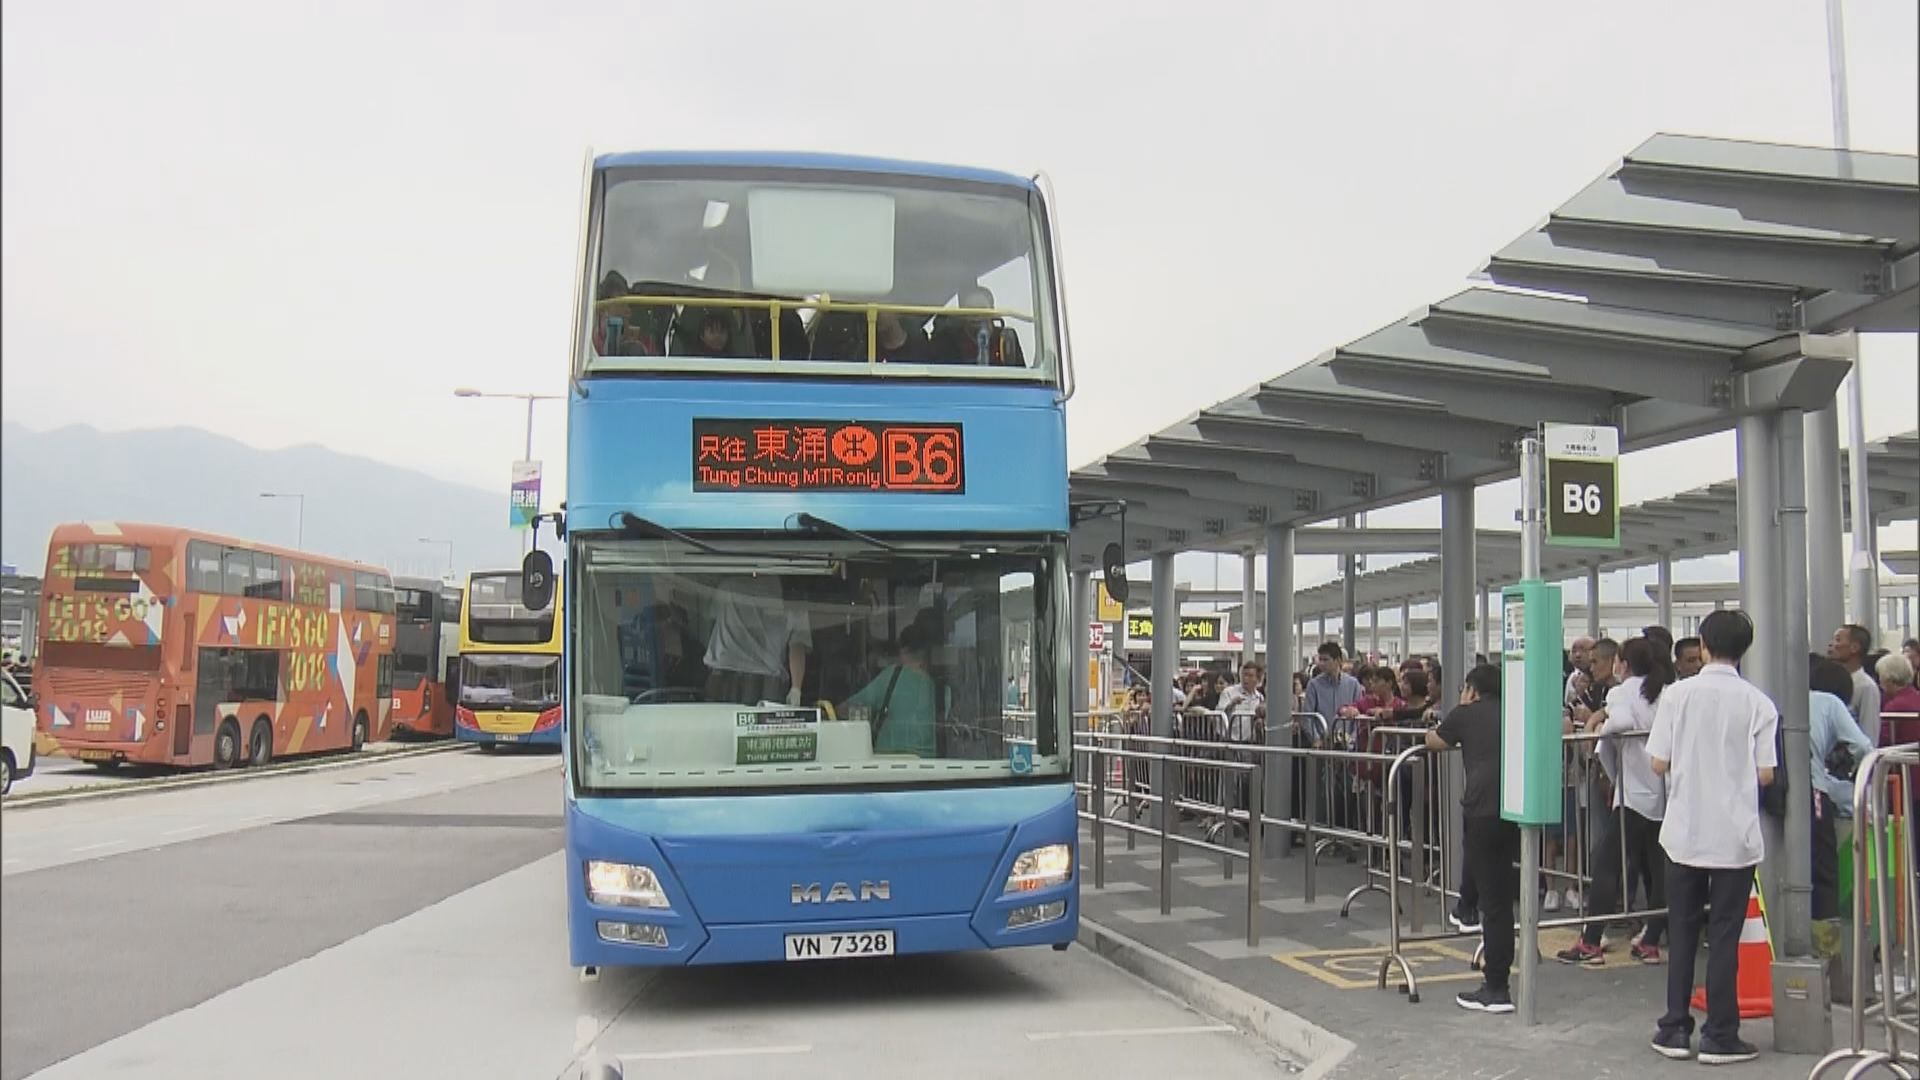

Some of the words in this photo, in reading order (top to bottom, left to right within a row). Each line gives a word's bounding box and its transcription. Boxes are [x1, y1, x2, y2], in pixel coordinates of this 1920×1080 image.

[699, 435, 747, 462] 只往
[753, 425, 828, 463] 東涌
[888, 434, 954, 484] B6
[699, 466, 741, 488] Tung
[745, 466, 799, 488] Chung
[802, 467, 844, 485] MTR
[846, 467, 881, 489] only
[1563, 483, 1601, 516] B6
[114, 597, 148, 621] GO
[791, 879, 891, 904] MAN
[792, 936, 821, 957] VN
[830, 934, 888, 955] 7328
